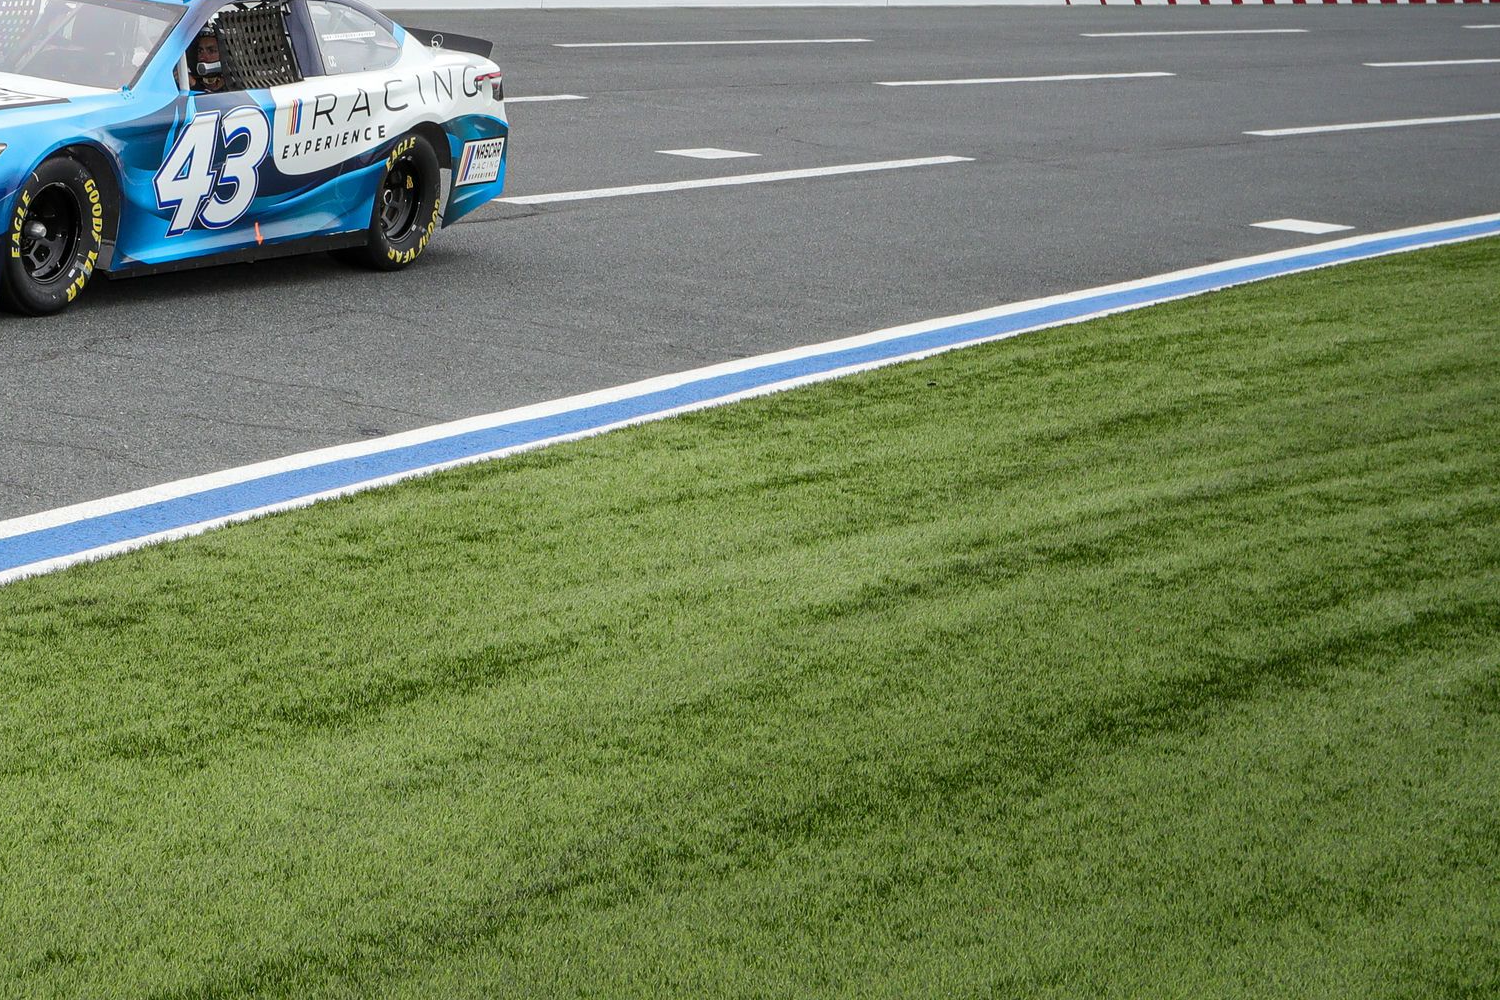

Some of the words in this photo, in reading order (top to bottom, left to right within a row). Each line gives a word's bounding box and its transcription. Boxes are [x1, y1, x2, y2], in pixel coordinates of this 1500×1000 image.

[311, 64, 479, 131] RACING
[281, 124, 386, 160] EXPERIENCE
[385, 136, 416, 173] EAGLE
[474, 141, 502, 160] NASCAR
[152, 104, 273, 239] 43
[471, 159, 499, 170] RACING
[11, 189, 32, 258] EAGLE
